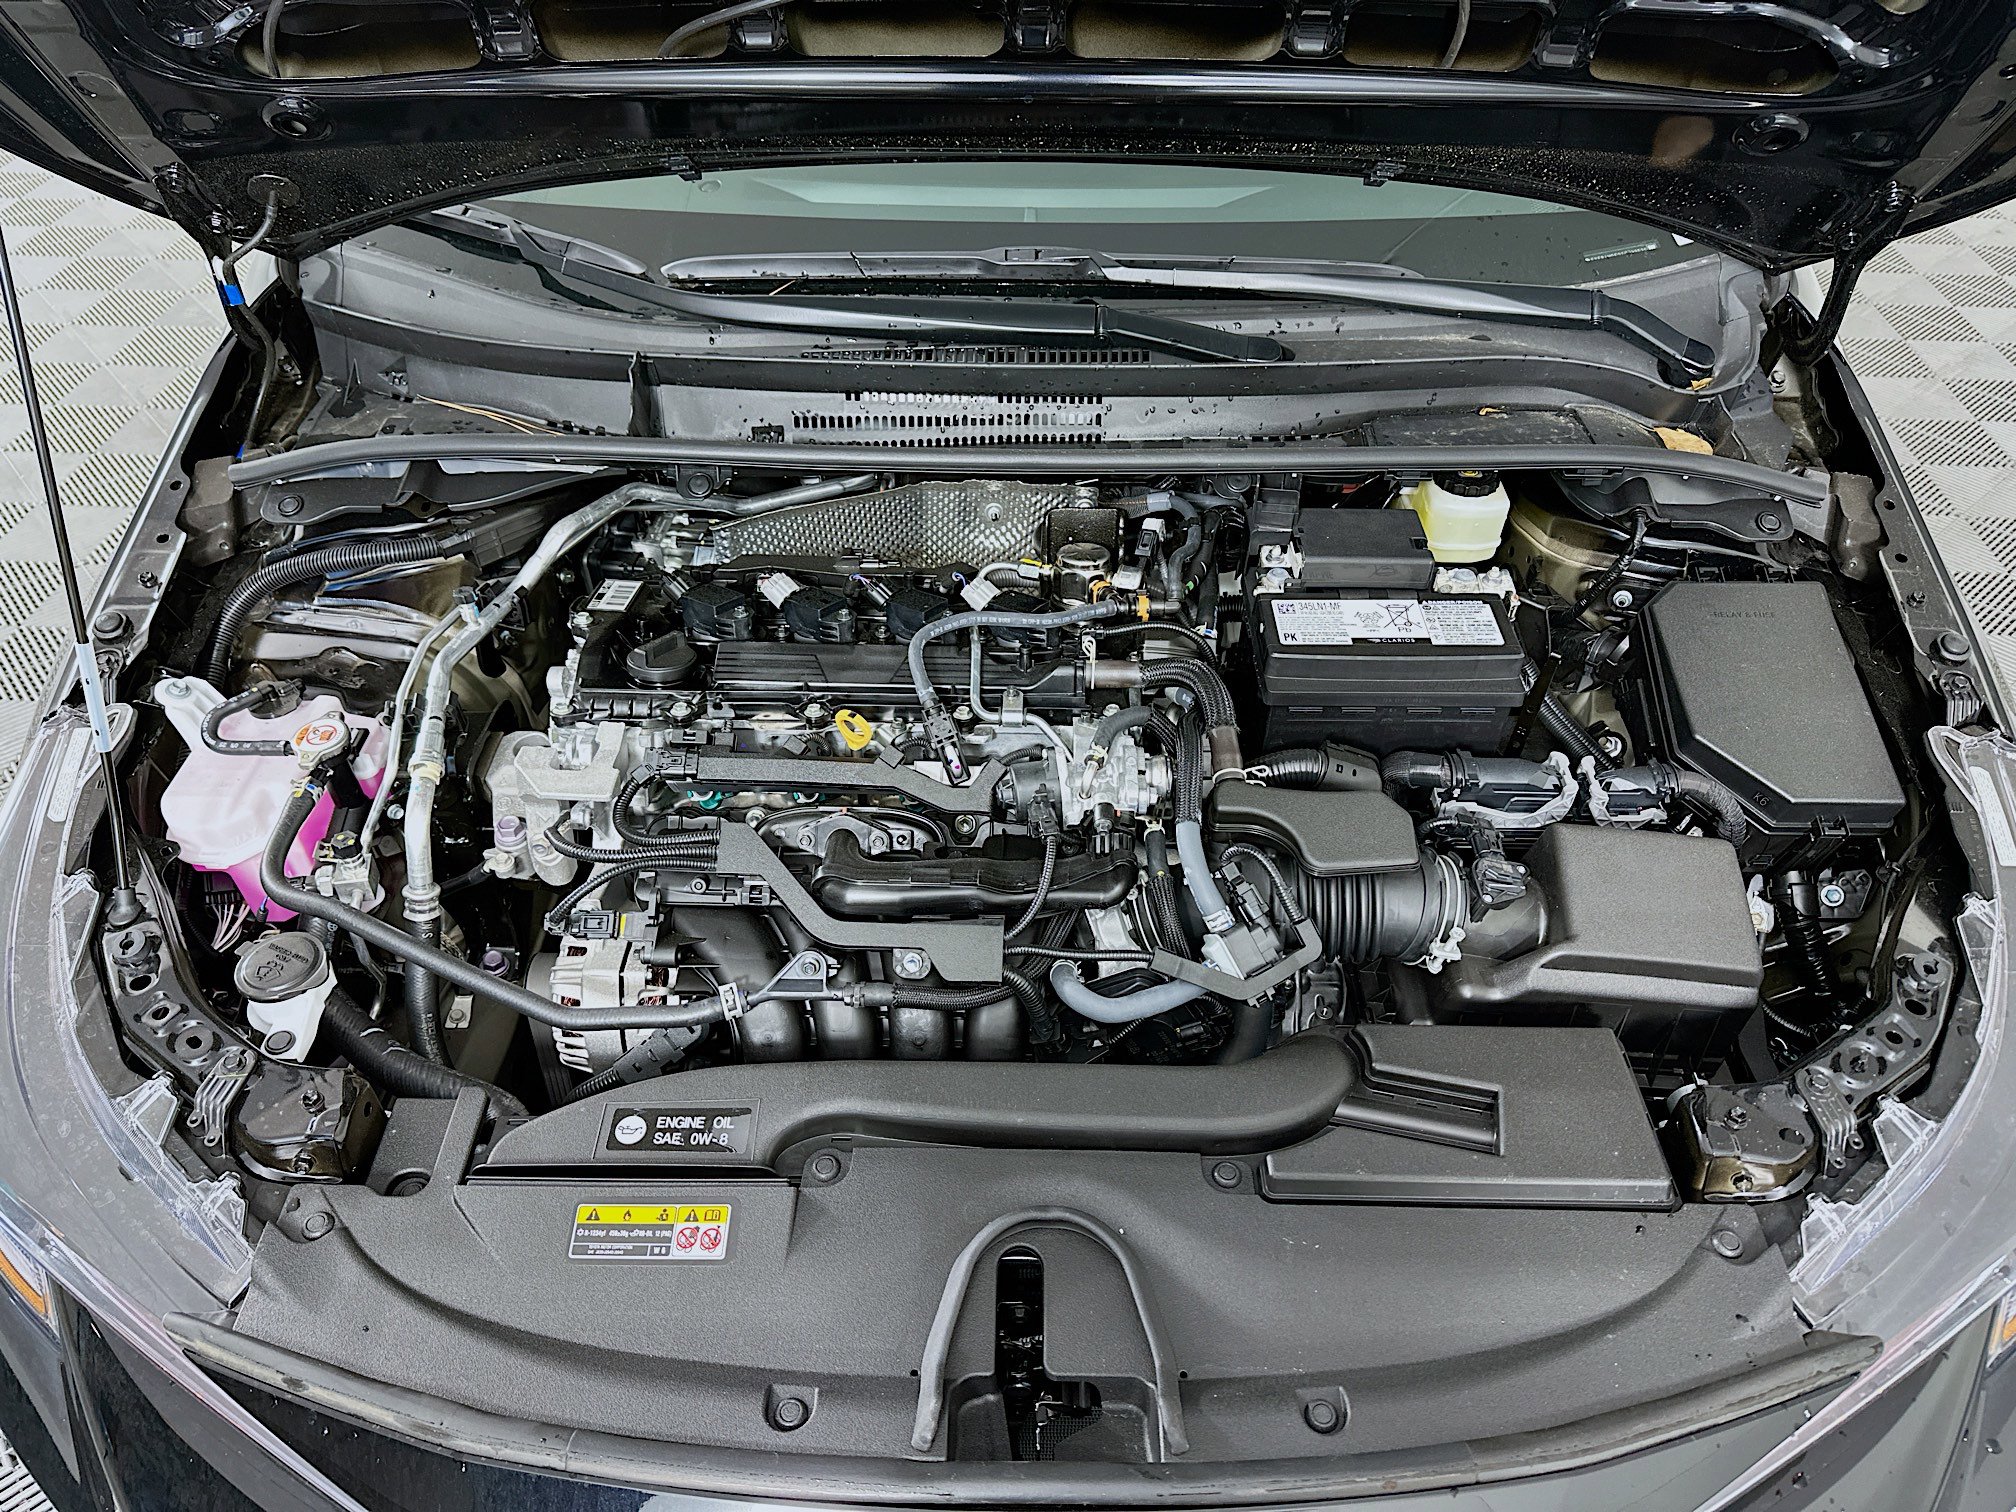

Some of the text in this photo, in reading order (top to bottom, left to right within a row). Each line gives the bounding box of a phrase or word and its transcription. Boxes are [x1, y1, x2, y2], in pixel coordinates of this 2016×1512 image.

[1283, 632, 1298, 642] PK
[1752, 792, 1770, 806] K6
[656, 1116, 735, 1129] ENGINE OIL
[689, 1132, 729, 1146] 0W-8
